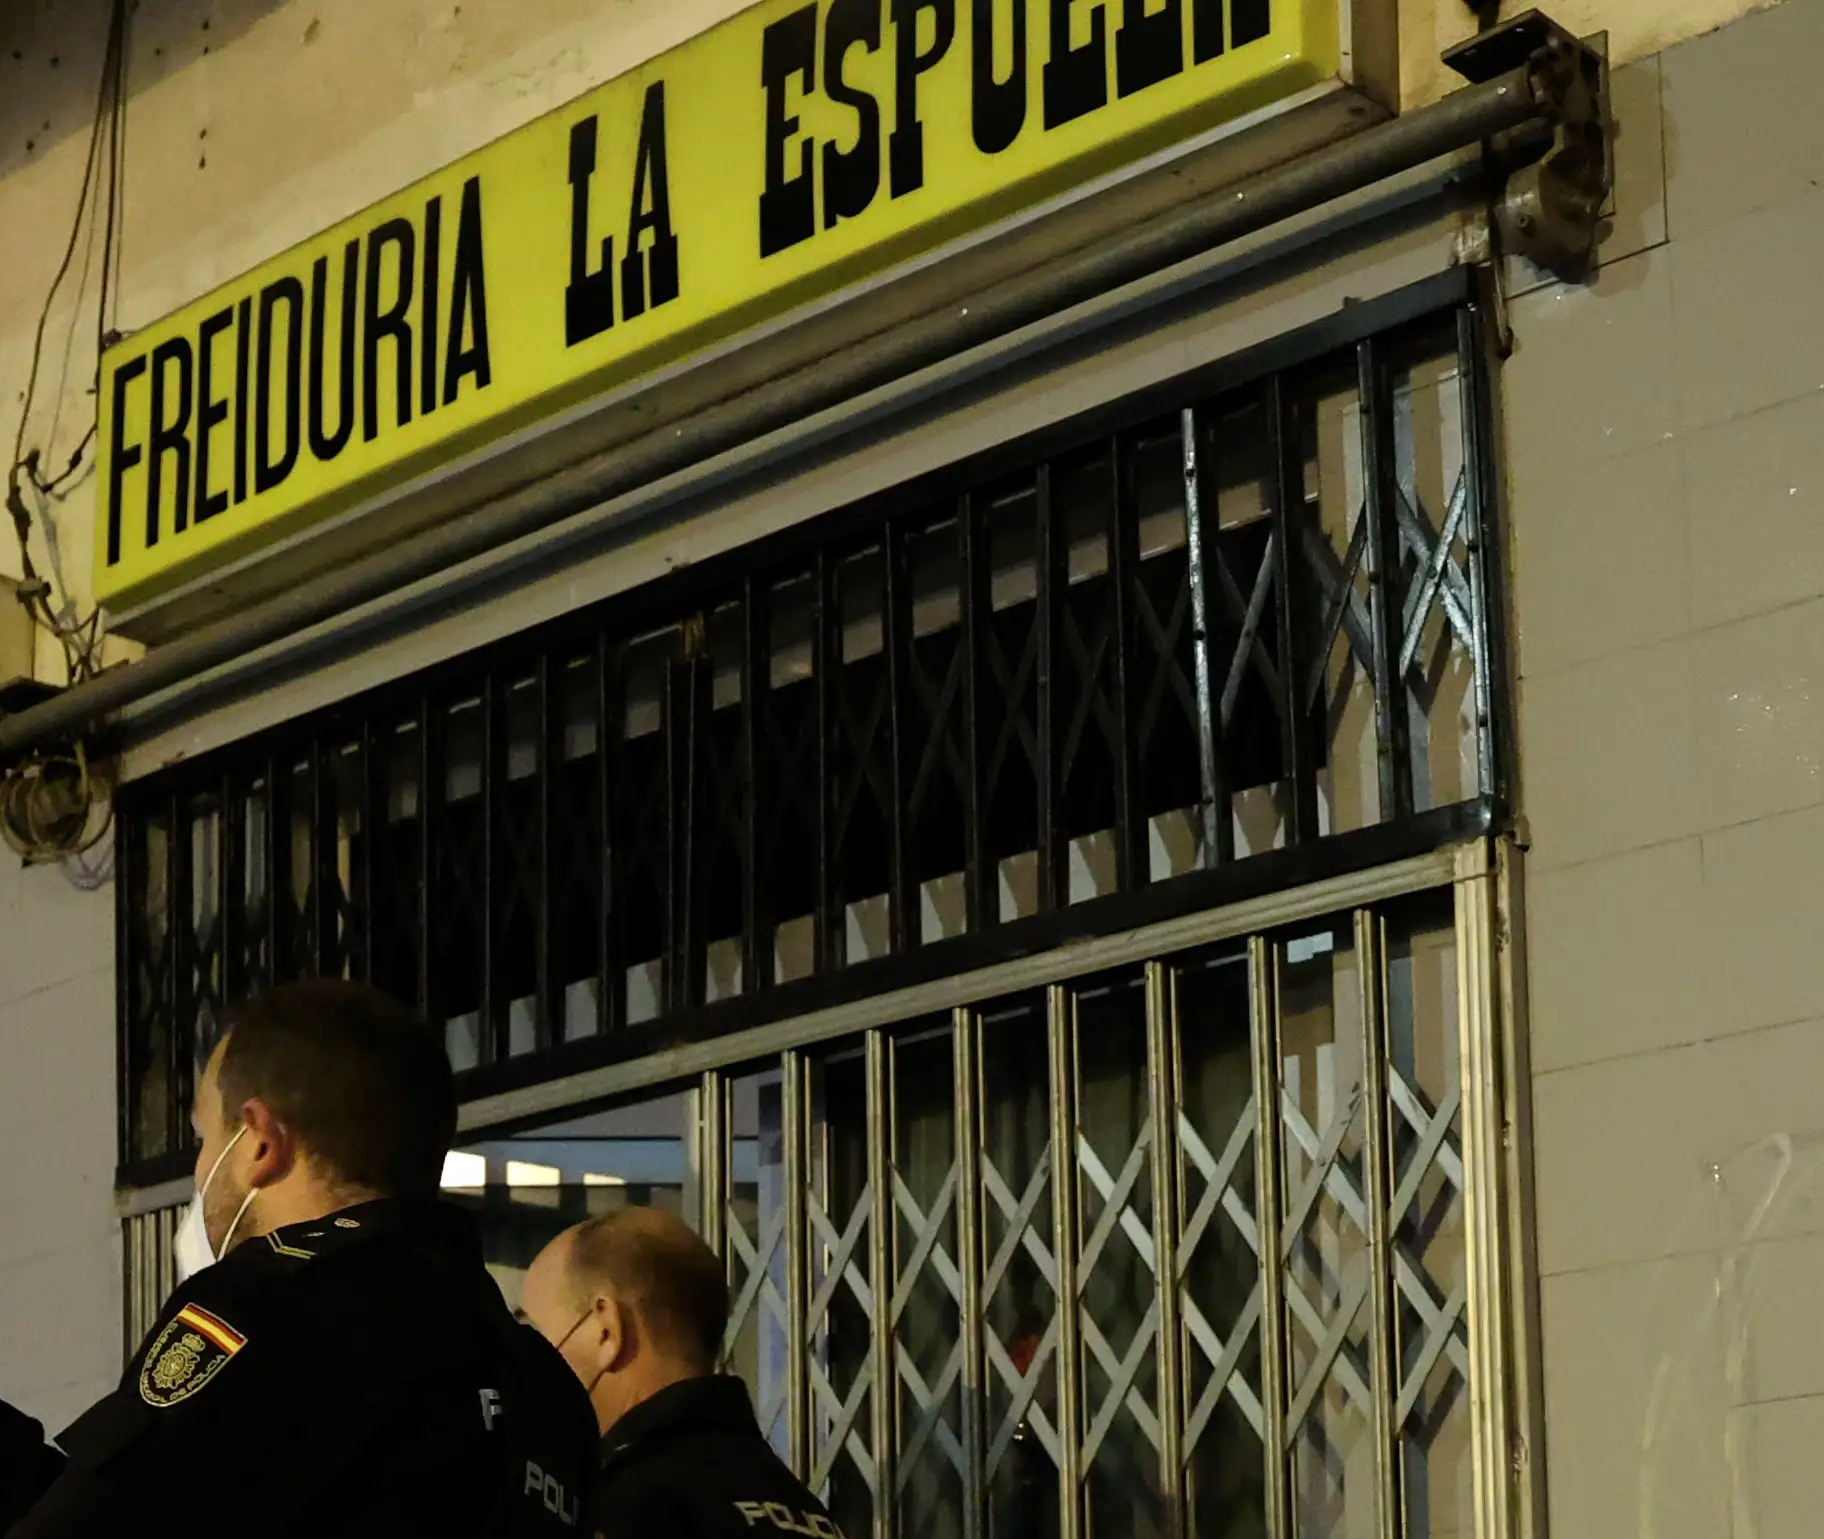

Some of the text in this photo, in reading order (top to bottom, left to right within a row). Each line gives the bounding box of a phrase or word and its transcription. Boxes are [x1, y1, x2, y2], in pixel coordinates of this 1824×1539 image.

[106, 0, 1271, 568] FREIDURIA LA ESPUE
